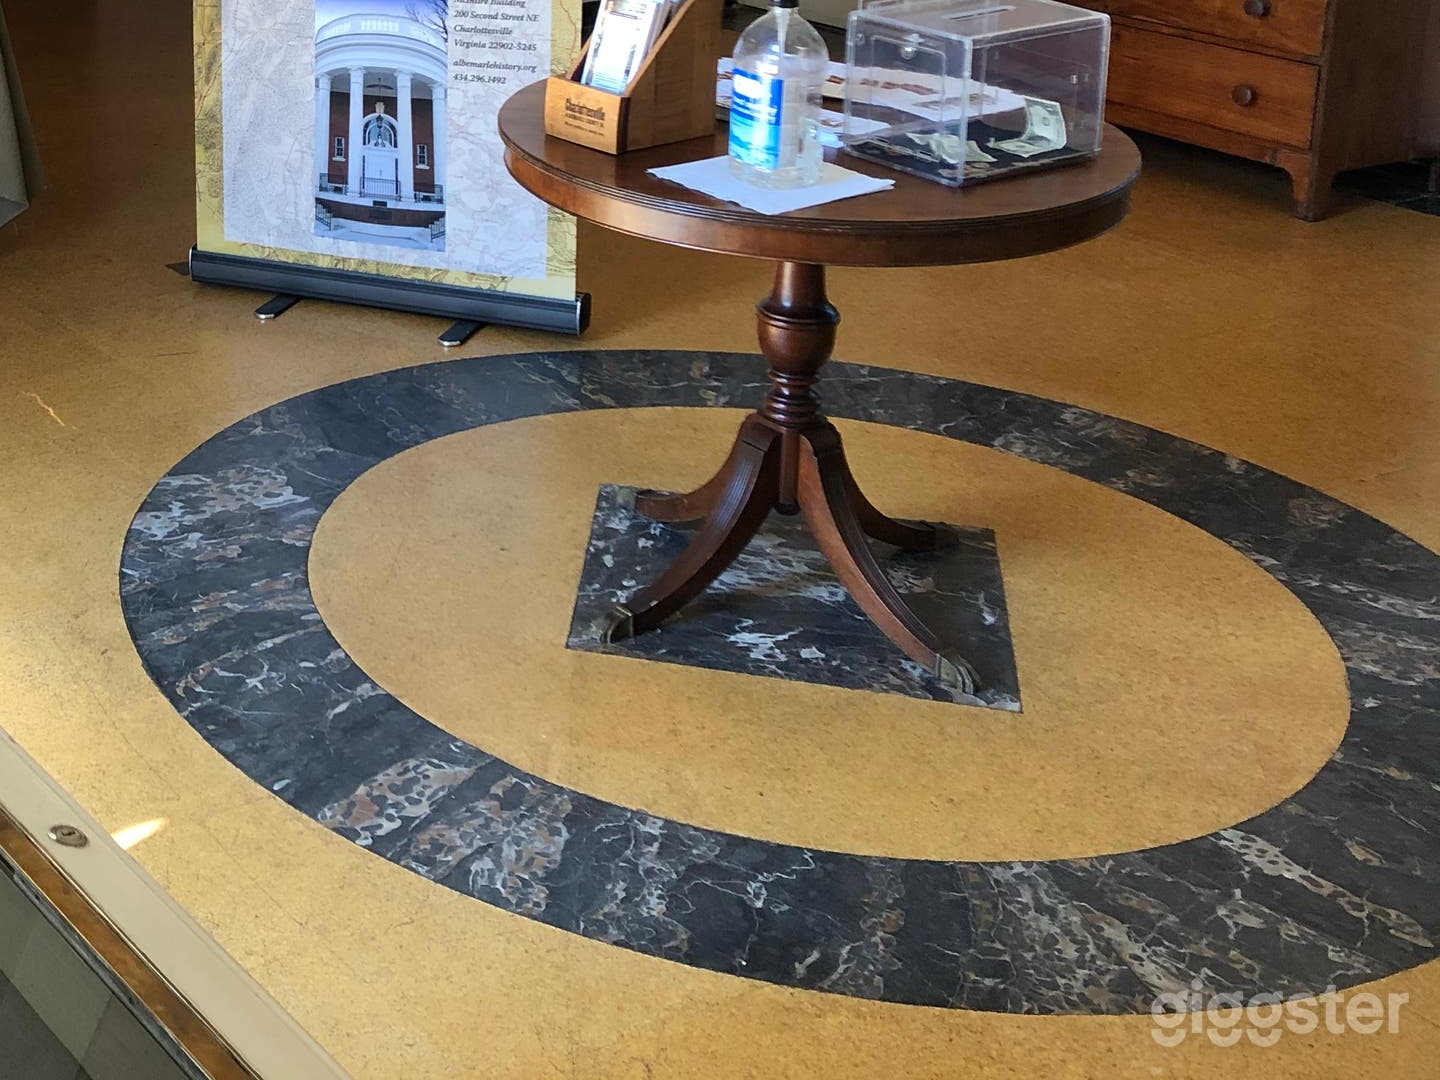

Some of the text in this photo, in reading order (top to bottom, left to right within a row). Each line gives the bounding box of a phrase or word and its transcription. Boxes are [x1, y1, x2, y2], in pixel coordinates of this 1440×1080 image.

[454, 10, 468, 18] 200
[500, 13, 524, 21] Street
[526, 14, 540, 22] NE
[454, 25, 512, 35] Charlottesville
[454, 40, 486, 49] Virginia
[453, 59, 537, 73] albemarlehistory.org
